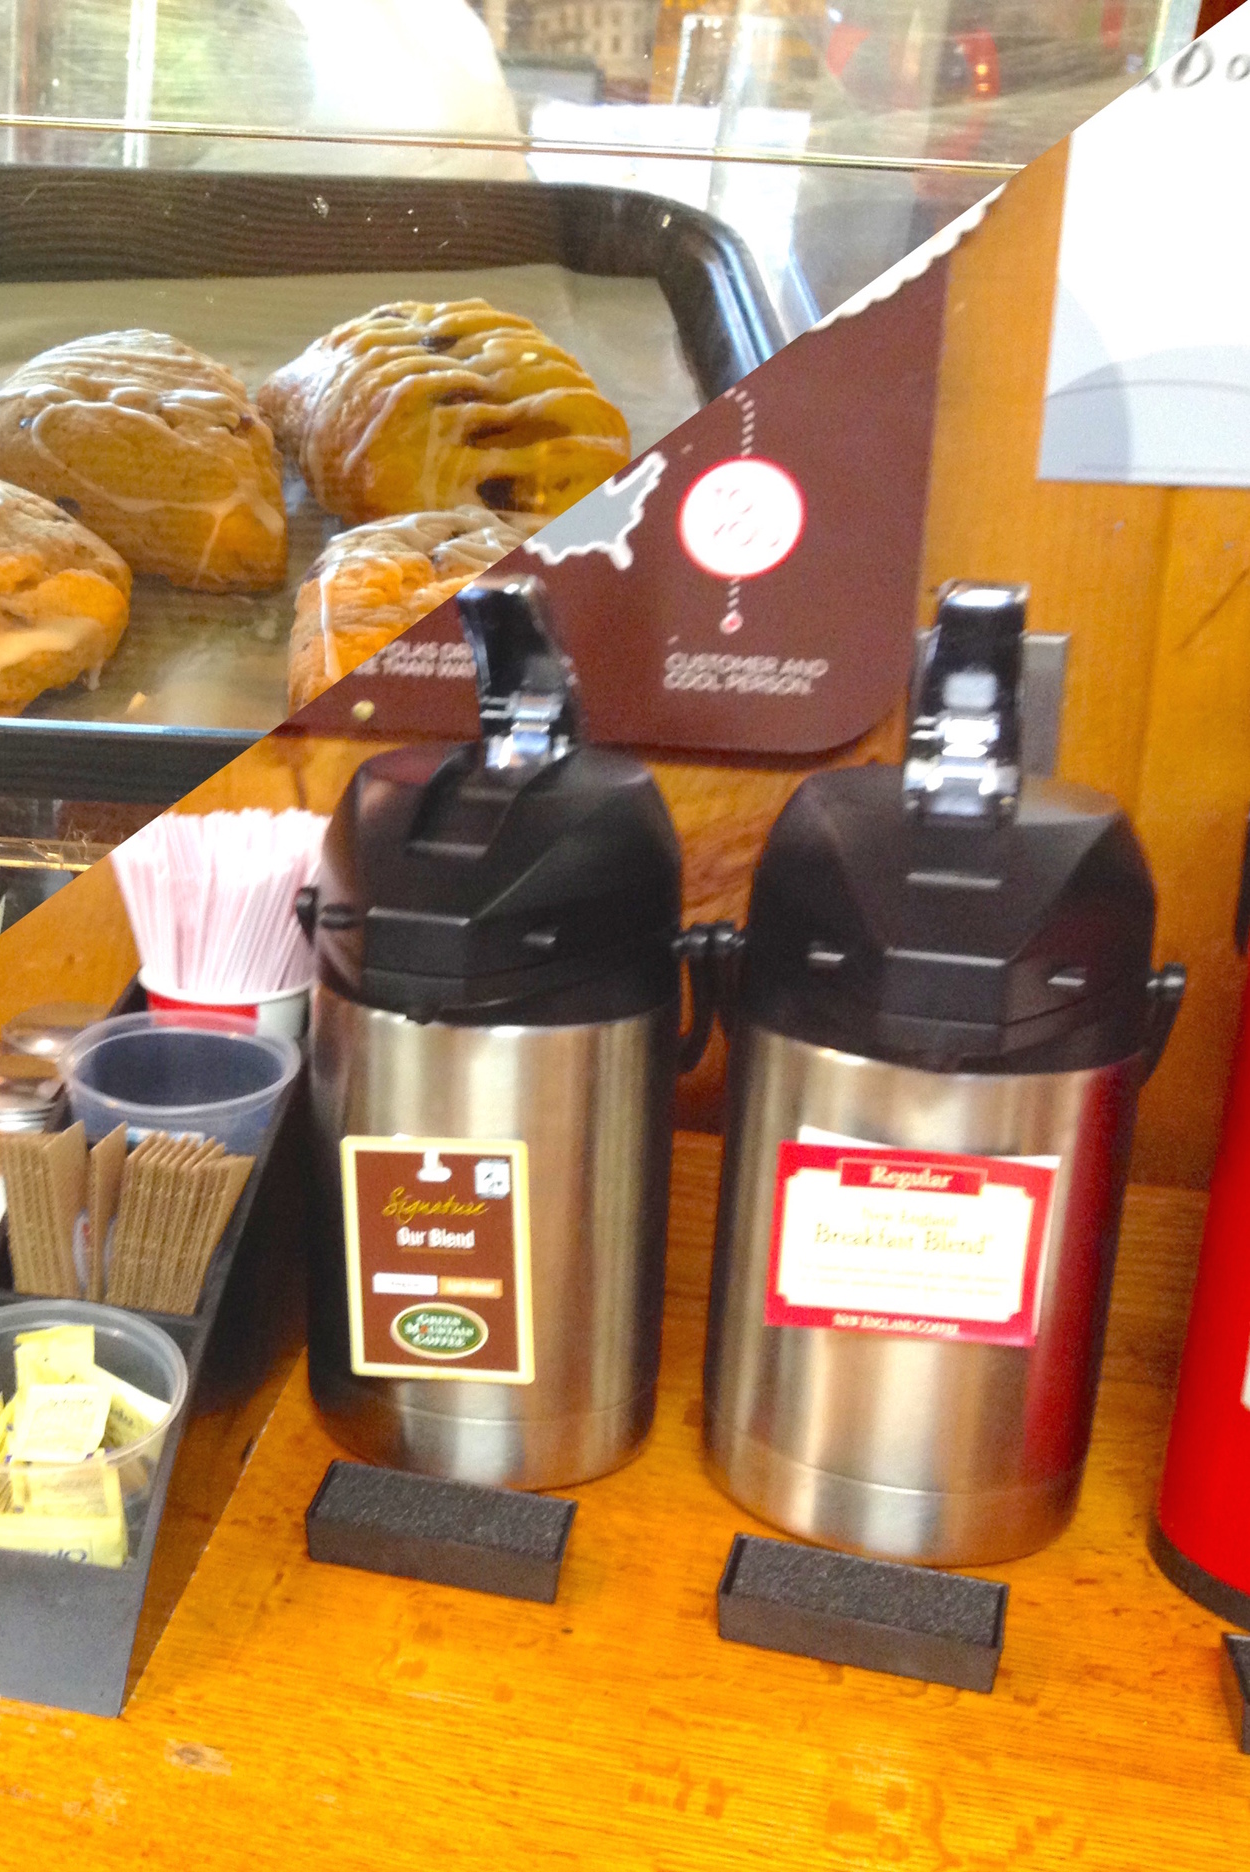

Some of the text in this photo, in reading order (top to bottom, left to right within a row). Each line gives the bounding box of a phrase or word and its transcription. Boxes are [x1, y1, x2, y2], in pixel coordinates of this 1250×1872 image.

[664, 652, 829, 679] CUSTOMER AND
[663, 670, 723, 693] COOL
[870, 1164, 954, 1190] Regular
[381, 1186, 490, 1226] Signature
[396, 1226, 475, 1250] Our Blend
[813, 1221, 987, 1256] Breakfast Blend
[416, 1313, 462, 1326] GREEN
[832, 1312, 859, 1327] NEW
[859, 1315, 917, 1332] ENGLAND
[412, 1334, 467, 1348] COFFEE
